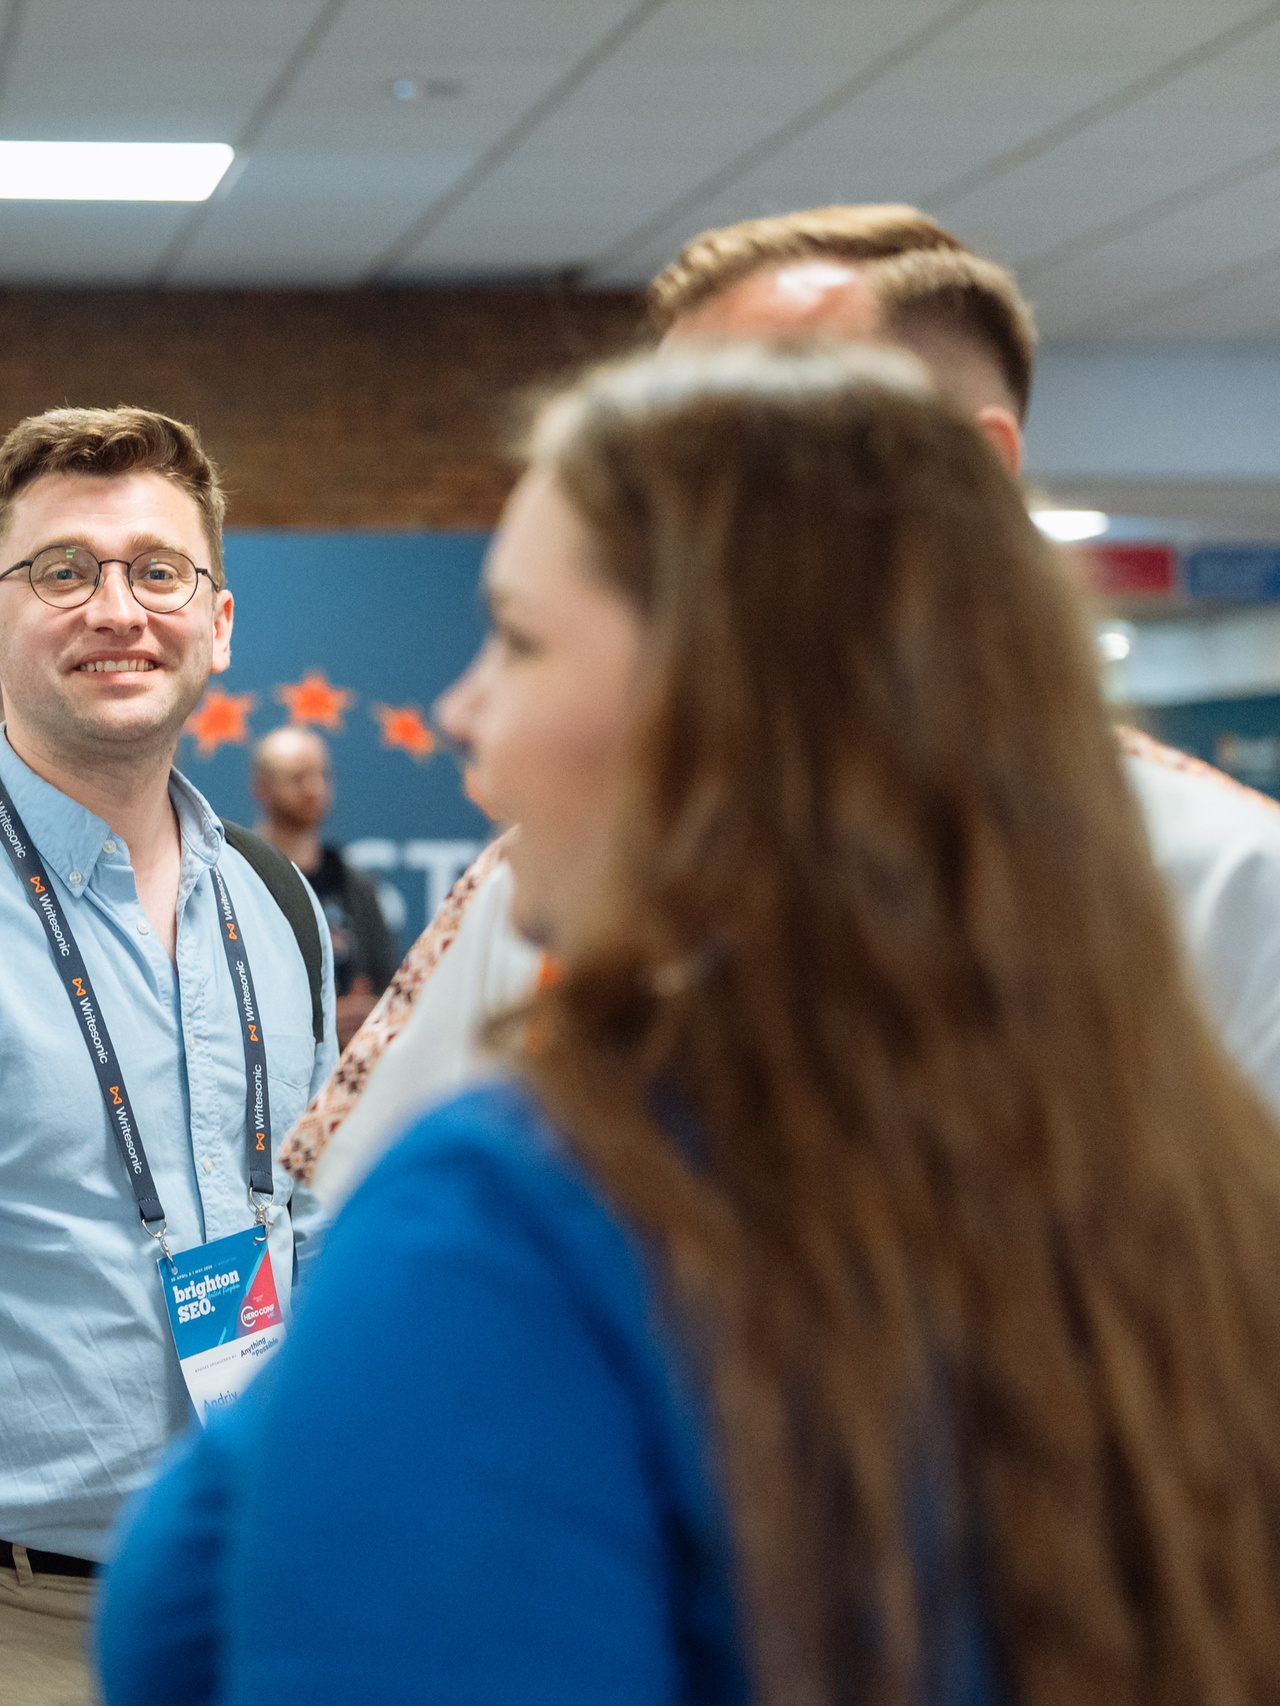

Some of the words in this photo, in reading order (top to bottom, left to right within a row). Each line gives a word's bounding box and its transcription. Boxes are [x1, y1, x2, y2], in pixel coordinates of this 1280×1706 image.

[39, 893, 70, 957] Writesonic
[235, 960, 255, 1022] Writesonic
[79, 997, 108, 1064] Writesonic
[253, 1064, 265, 1130] Writesonic
[116, 1106, 142, 1175] Writesonic
[172, 1270, 240, 1304] brighton
[177, 1298, 216, 1324] SEO.
[243, 1310, 259, 1321] HERO
[259, 1304, 274, 1315] CONF
[240, 1337, 267, 1358] Anything
[255, 1337, 279, 1356] Possible
